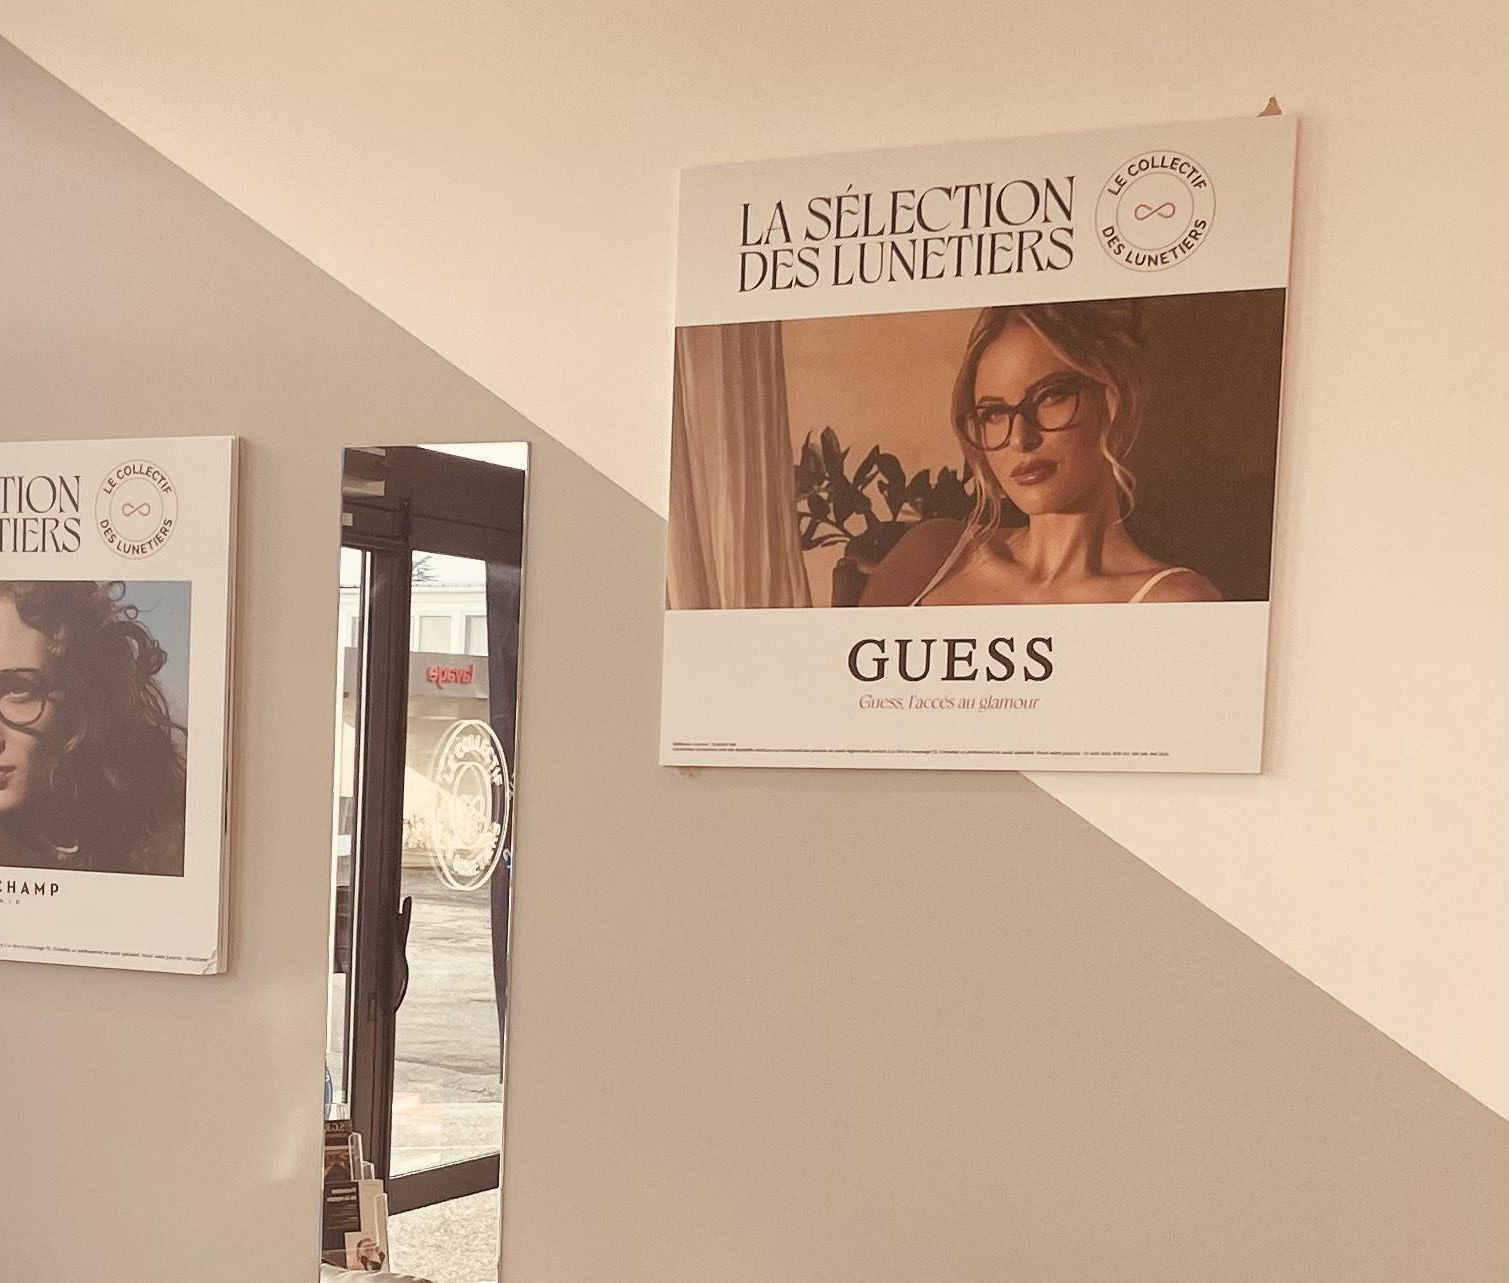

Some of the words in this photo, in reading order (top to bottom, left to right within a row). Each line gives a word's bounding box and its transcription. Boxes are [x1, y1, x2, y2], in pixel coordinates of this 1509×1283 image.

[1108, 175, 1127, 195] LE
[1127, 155, 1207, 189] COLLECTIF
[740, 199, 792, 246] LA
[804, 175, 1076, 241] SÉLECTION
[739, 247, 820, 293] DES
[832, 227, 1075, 286] LUNETIERS
[1102, 226, 1125, 255] DES
[1125, 219, 1207, 267] LUNETIERS
[103, 477, 117, 494] LE
[116, 464, 172, 494] COLLECTIF
[100, 519, 117, 544] DES
[116, 518, 173, 555] LUNETIERS
[848, 637, 1053, 682] GUESS
[859, 694, 905, 711] Guess,
[957, 698, 976, 710] au
[978, 694, 1041, 713] glamour
